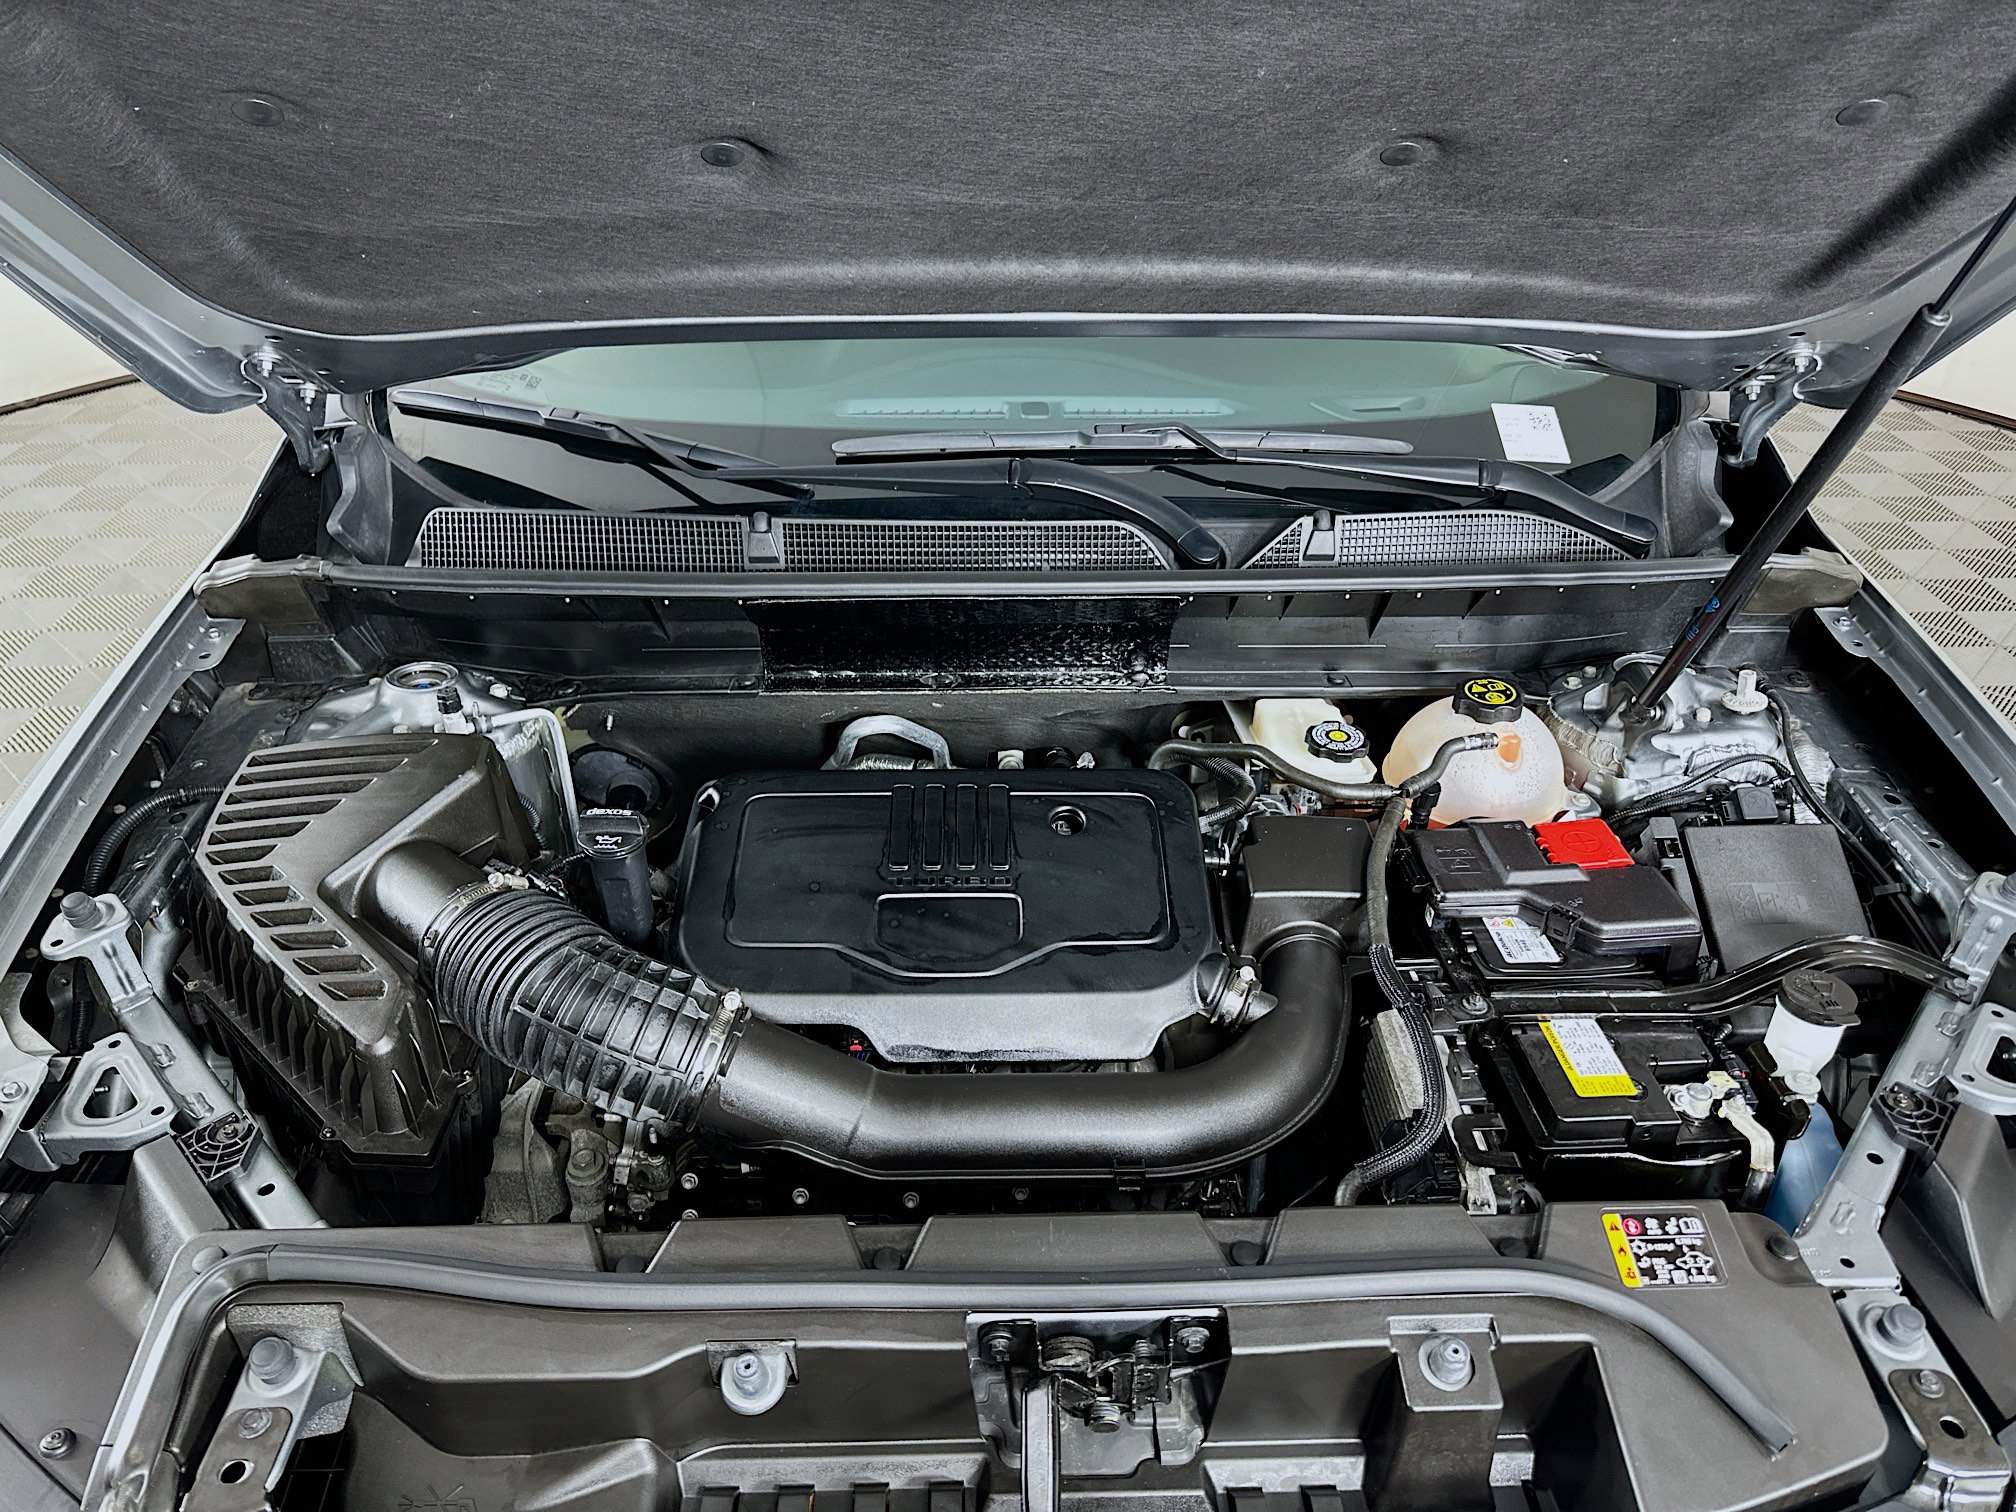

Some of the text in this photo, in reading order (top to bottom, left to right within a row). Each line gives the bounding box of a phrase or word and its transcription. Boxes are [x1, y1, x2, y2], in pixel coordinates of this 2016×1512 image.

[586, 807, 634, 816] dexos
[888, 876, 1013, 887] TURBO
[1544, 1025, 1571, 1066] DANGER POISON
